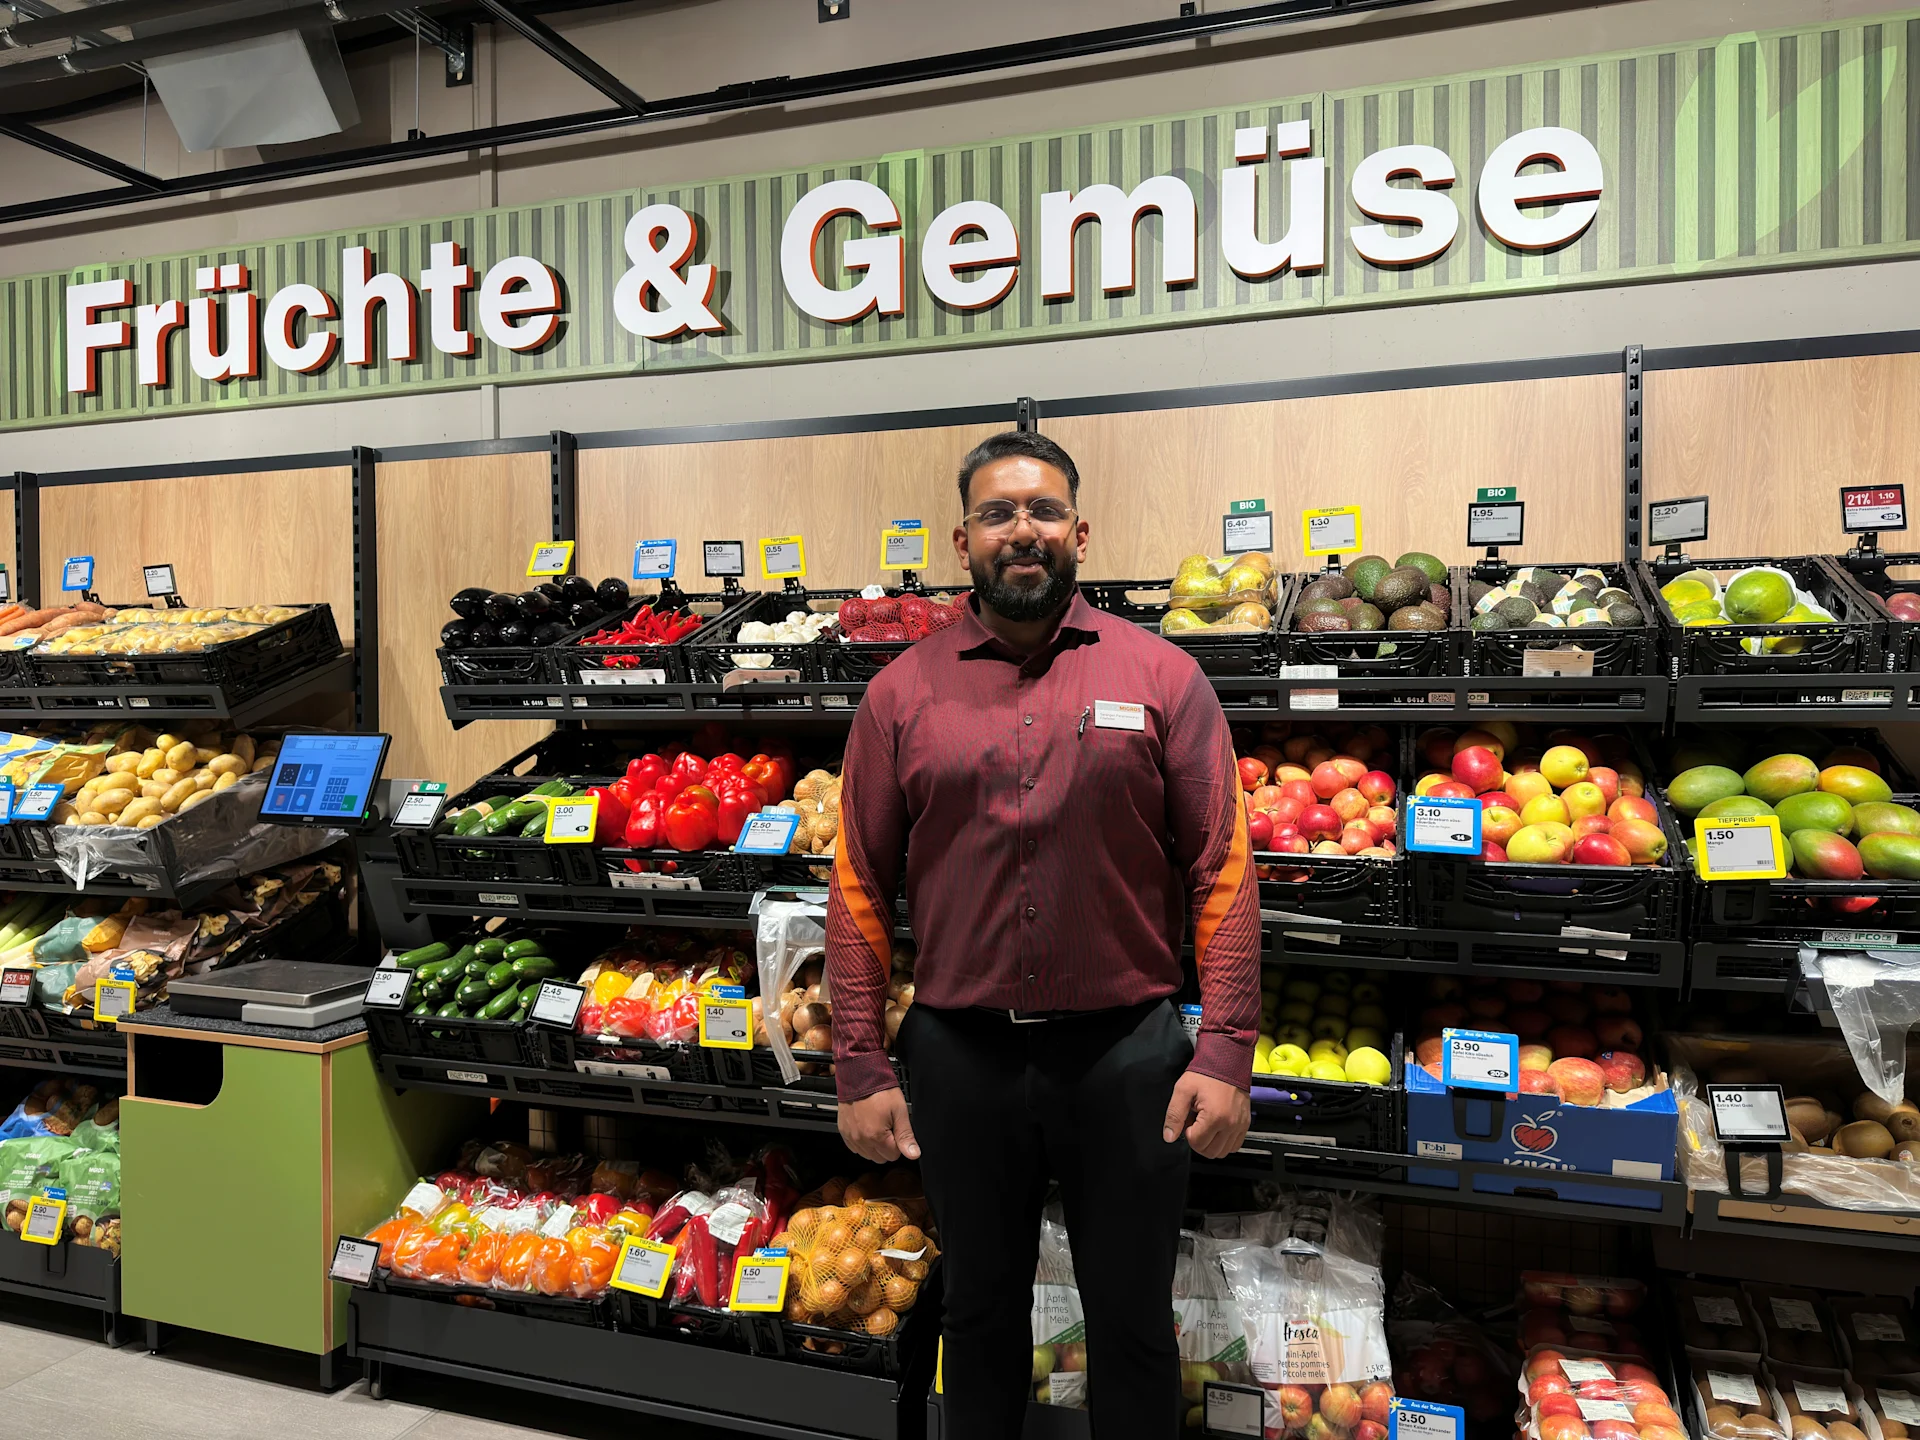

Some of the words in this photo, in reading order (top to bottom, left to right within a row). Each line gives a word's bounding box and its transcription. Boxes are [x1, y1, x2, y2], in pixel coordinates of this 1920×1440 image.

[66, 241, 563, 394] Früchte
[613, 203, 727, 340] &
[780, 119, 1604, 323] Gemüse
[1487, 488, 1506, 497] BIO
[1878, 492, 1895, 500] 1.10
[1847, 492, 1871, 506] 21%
[1239, 501, 1256, 510] BIO
[1472, 509, 1493, 517] 1.95
[1654, 506, 1679, 516] 3.20
[1227, 519, 1248, 527] 6.40
[1310, 517, 1330, 526] 1.30
[888, 537, 904, 545] 1.00
[766, 545, 782, 553] 0.55
[1671, 656, 1679, 680] LL4310
[425, 783, 440, 791] BIO
[556, 806, 574, 814] 3.00
[770, 807, 786, 815] BIO
[1417, 808, 1441, 817] 3.10
[1706, 830, 1734, 840] 1.50
[1854, 933, 1881, 941] IFCO
[4, 972, 17, 984] 25%
[375, 973, 392, 981] 3.90
[101, 987, 114, 995] 1.30
[543, 985, 562, 996] 2.45
[706, 1007, 724, 1016] 1.40
[1453, 1041, 1480, 1052] 3.90
[1490, 1070, 1505, 1078] 202
[1715, 1093, 1742, 1103] 1.40
[33, 1205, 47, 1214] 2.90
[340, 1242, 356, 1252] 1.95
[639, 1239, 662, 1249] TIEFPREIS
[628, 1247, 646, 1258] 1.60
[742, 1268, 761, 1277] 1.50
[1047, 1293, 1068, 1305] Äpfel
[1050, 1315, 1070, 1324] Mele
[1196, 1319, 1229, 1331] Pommes
[1283, 1321, 1320, 1341] fresca
[1213, 1332, 1229, 1342] Mele
[1376, 1363, 1385, 1373] kg
[1209, 1391, 1233, 1402] 4.55
[1399, 1412, 1426, 1425] 3.50
